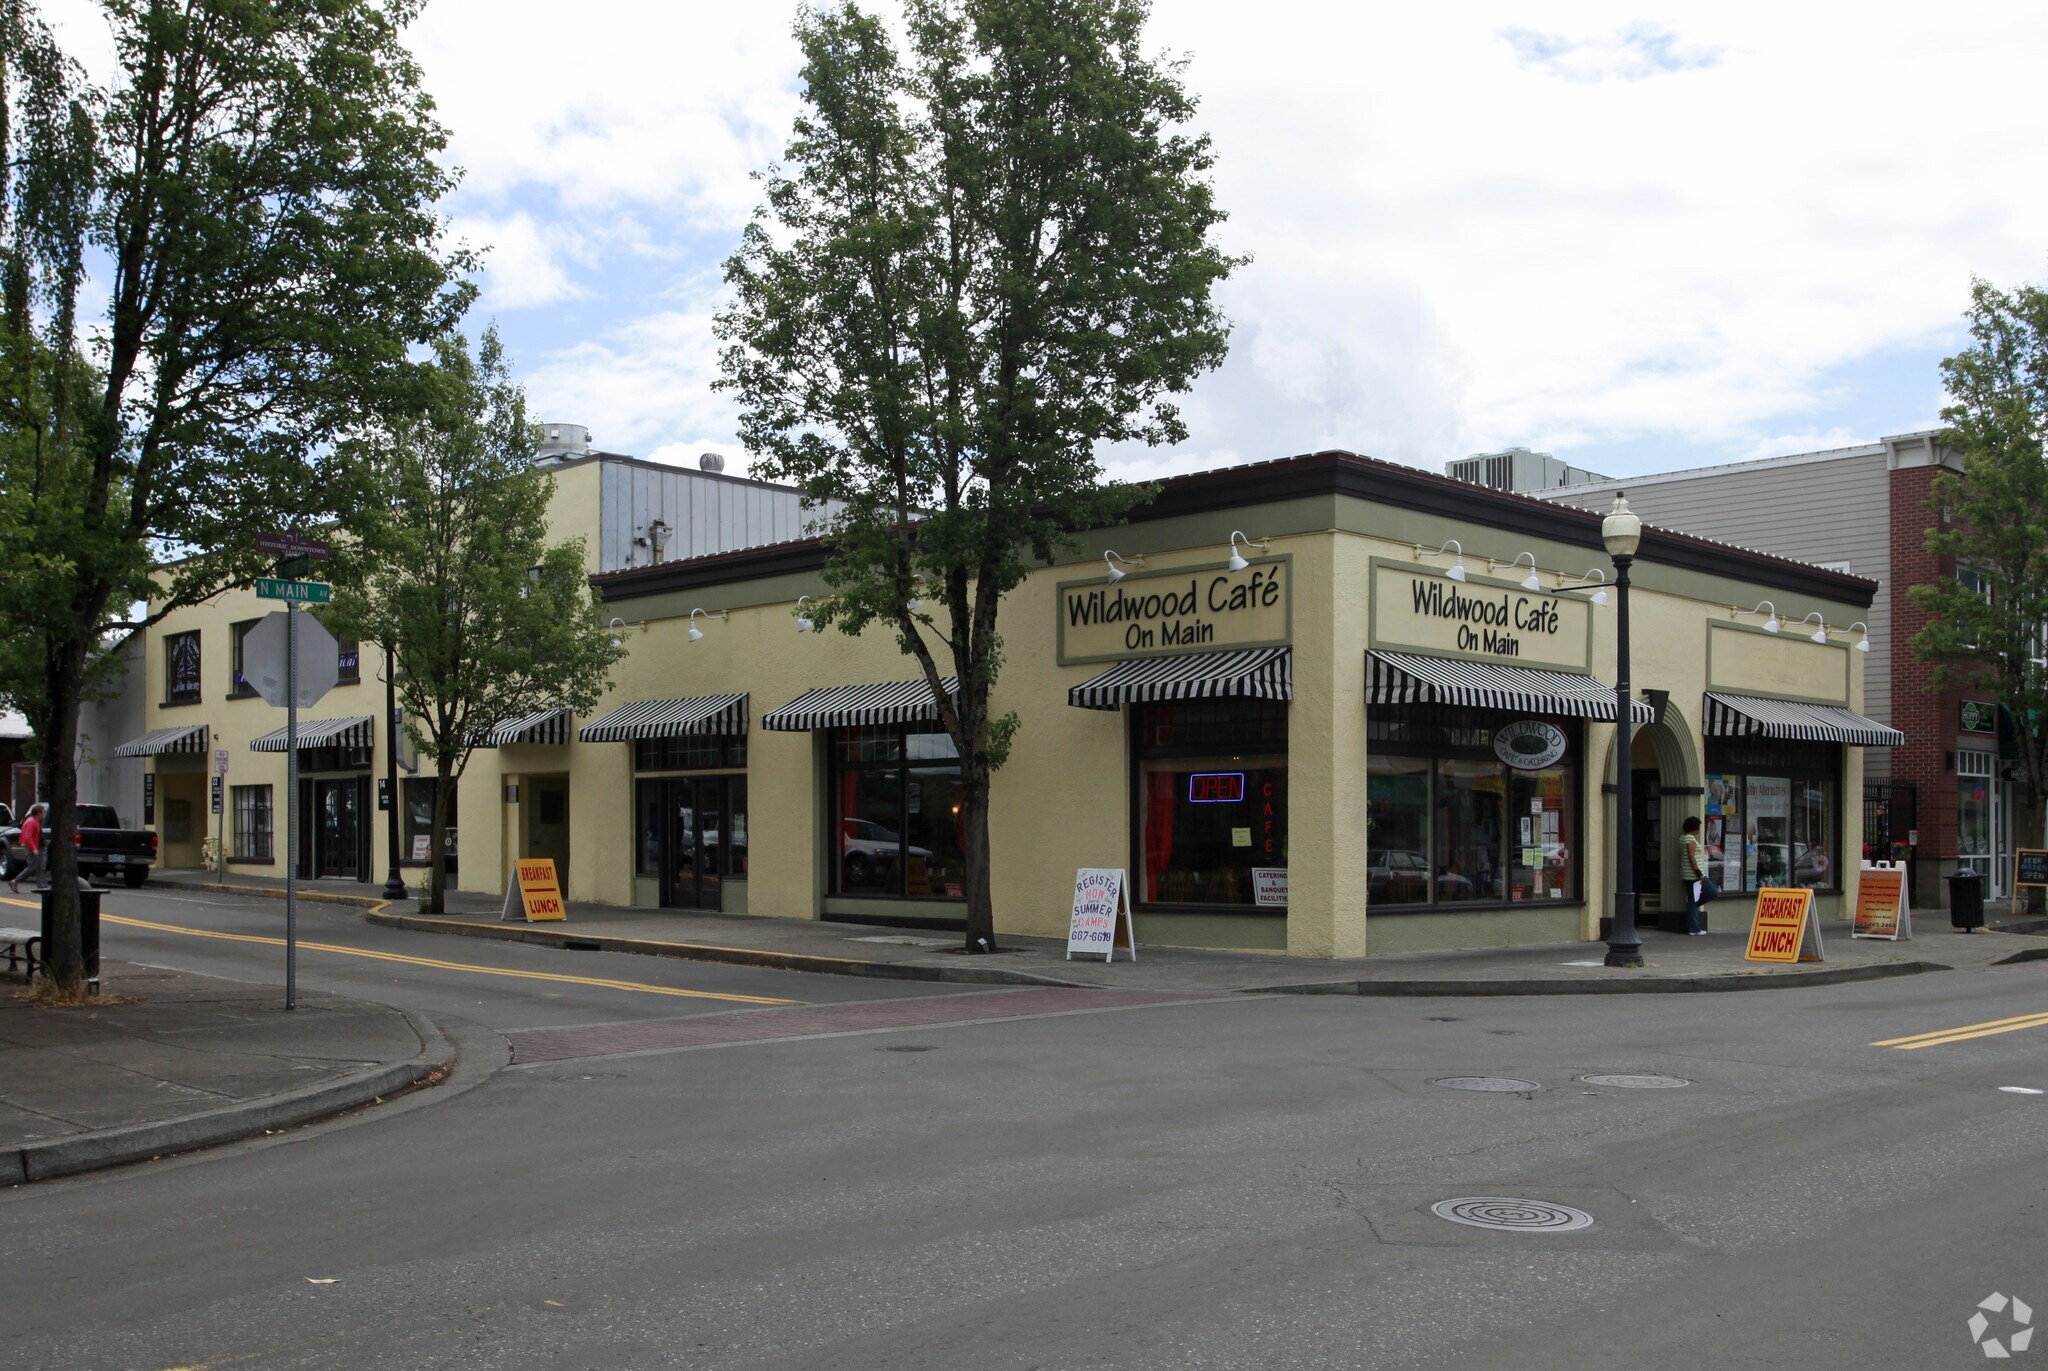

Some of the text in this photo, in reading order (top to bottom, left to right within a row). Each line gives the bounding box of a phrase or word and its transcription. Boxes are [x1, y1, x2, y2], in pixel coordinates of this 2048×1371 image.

[260, 541, 288, 549] HISTORIC
[291, 545, 326, 554] DOWNTOWN
[260, 582, 269, 595] N
[275, 583, 309, 599] MAIN
[1068, 566, 1279, 627] Wildwood Café
[1412, 579, 1559, 635] Wildwood Café
[1125, 619, 1214, 650] On Main
[1457, 624, 1519, 656] On Main
[1496, 722, 1562, 747] WILDWOOD
[1523, 750, 1558, 766] CATERING
[1192, 776, 1242, 799] OPEN
[1263, 783, 1273, 852] CAFE
[521, 866, 554, 881] BREAKFAST
[1076, 874, 1117, 898] REGISTER
[1086, 889, 1105, 900] NOW
[529, 899, 560, 913] LUNCH
[1074, 904, 1112, 917] SUMMER
[1760, 896, 1803, 919] BREAKFAST
[1078, 917, 1109, 929] CAMPS
[1754, 931, 1796, 953] LUNCH
